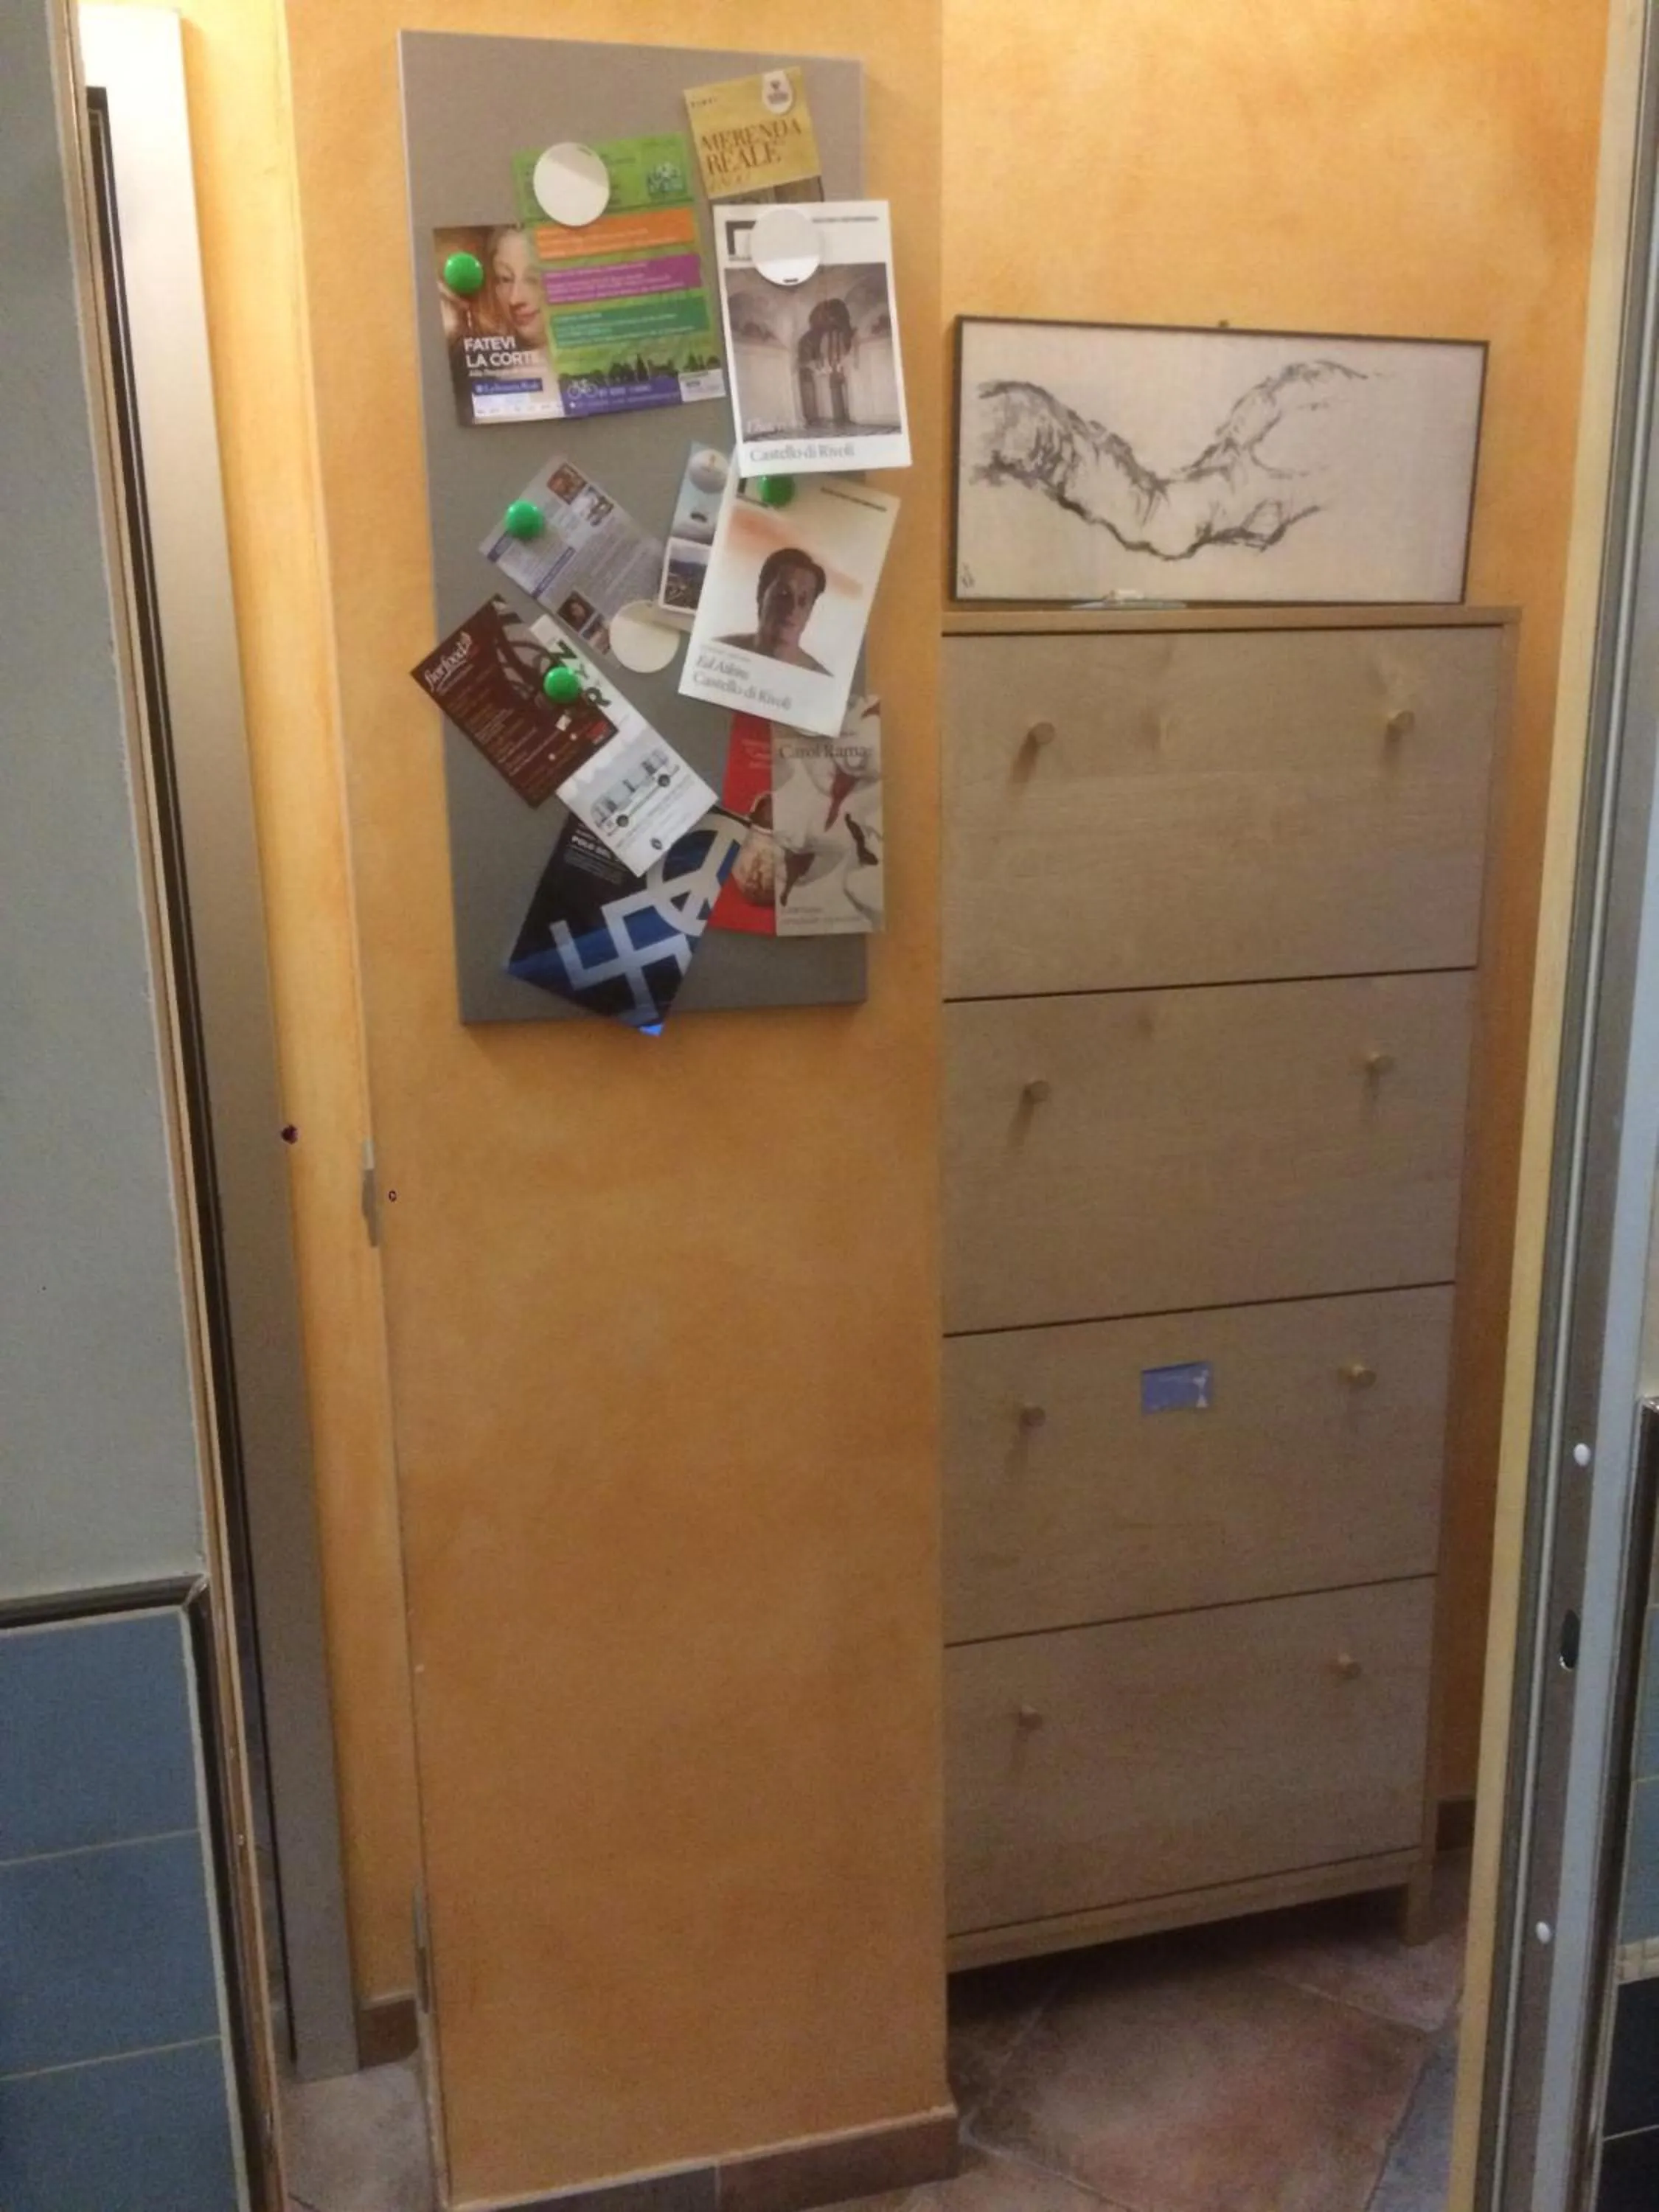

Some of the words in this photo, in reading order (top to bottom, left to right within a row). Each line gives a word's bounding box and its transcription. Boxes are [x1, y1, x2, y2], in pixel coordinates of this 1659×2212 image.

[702, 118, 801, 151] MERENDA
[706, 142, 782, 175] REALE
[463, 335, 516, 352] FATEVI
[465, 353, 487, 369] LA
[750, 444, 802, 462] Castello
[779, 743, 821, 759] Carol
[824, 743, 869, 758] Rama
